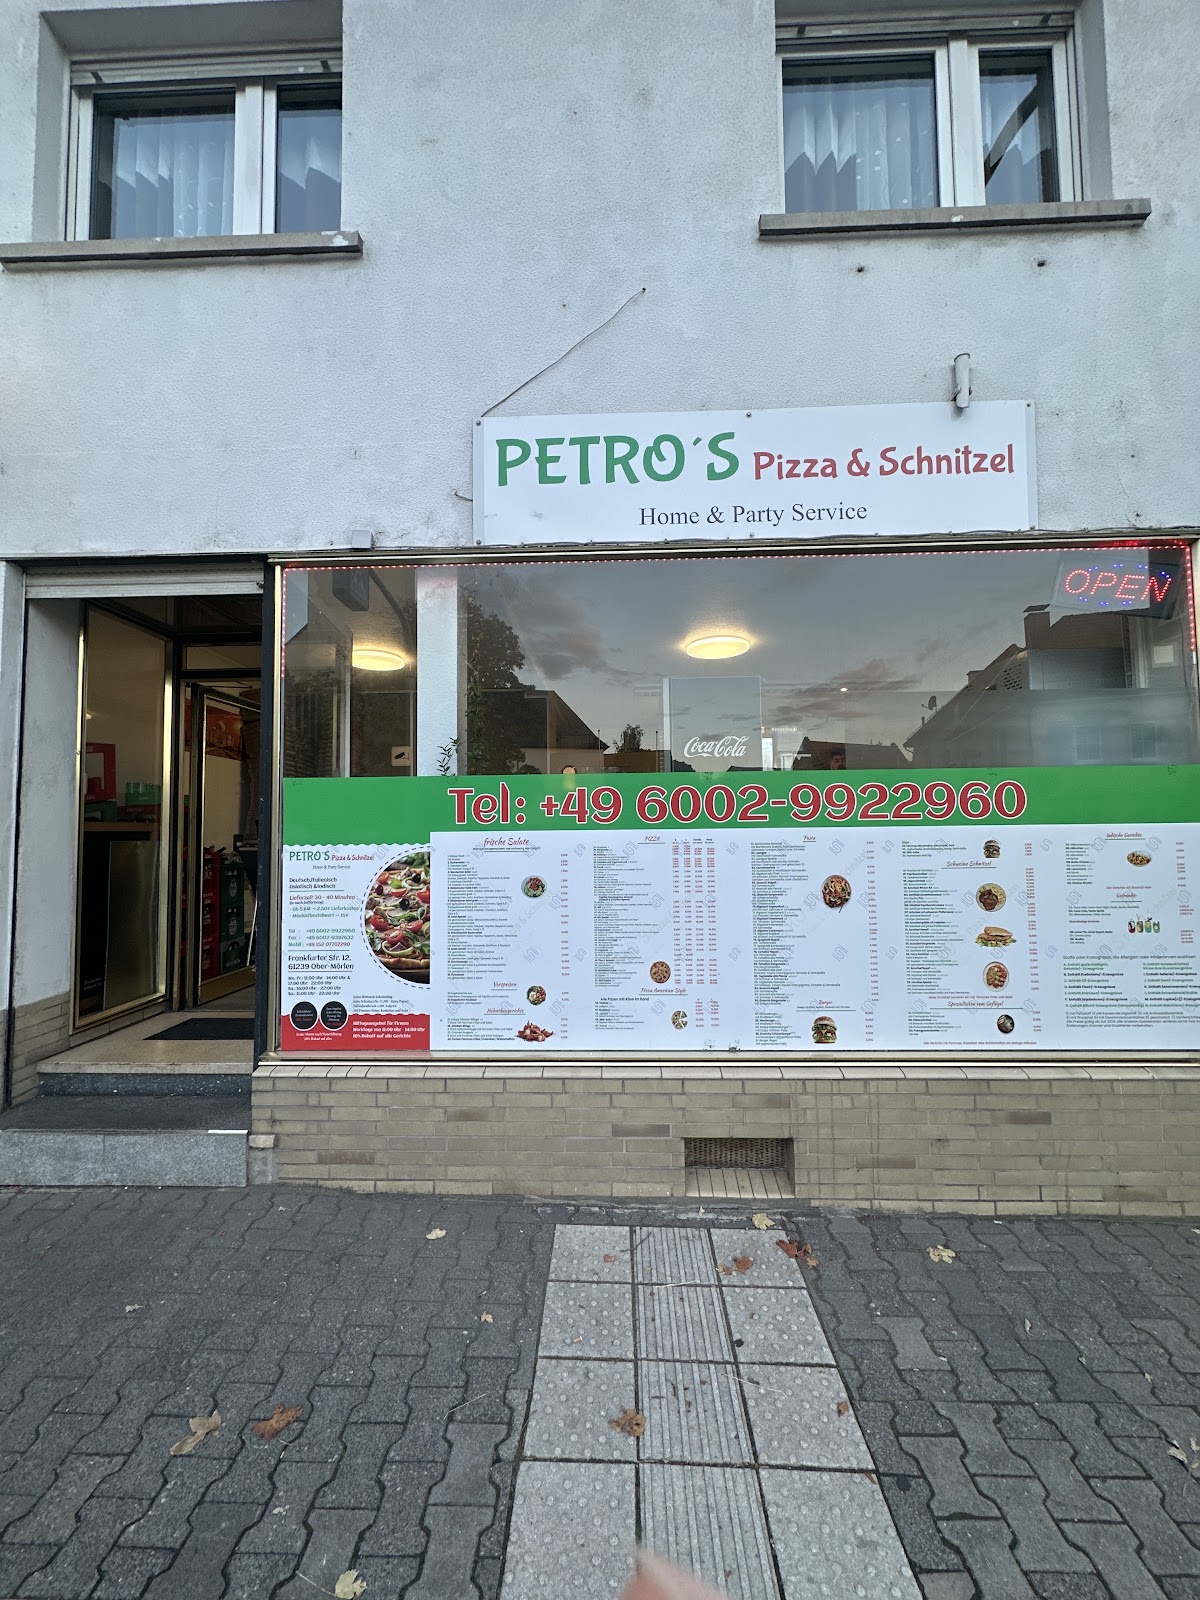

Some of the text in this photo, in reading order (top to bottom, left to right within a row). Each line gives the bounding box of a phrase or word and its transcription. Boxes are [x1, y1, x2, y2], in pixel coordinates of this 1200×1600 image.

[753, 450, 837, 481] Pizza
[846, 448, 871, 477] &
[879, 444, 1015, 477] Schnitzel
[639, 503, 868, 527] Home & Party Service
[1065, 569, 1172, 602] OPEN
[683, 736, 750, 758] Coca-Cola
[448, 780, 1027, 825] Tel: +49 6002-9922960
[508, 837, 529, 845] Salate
